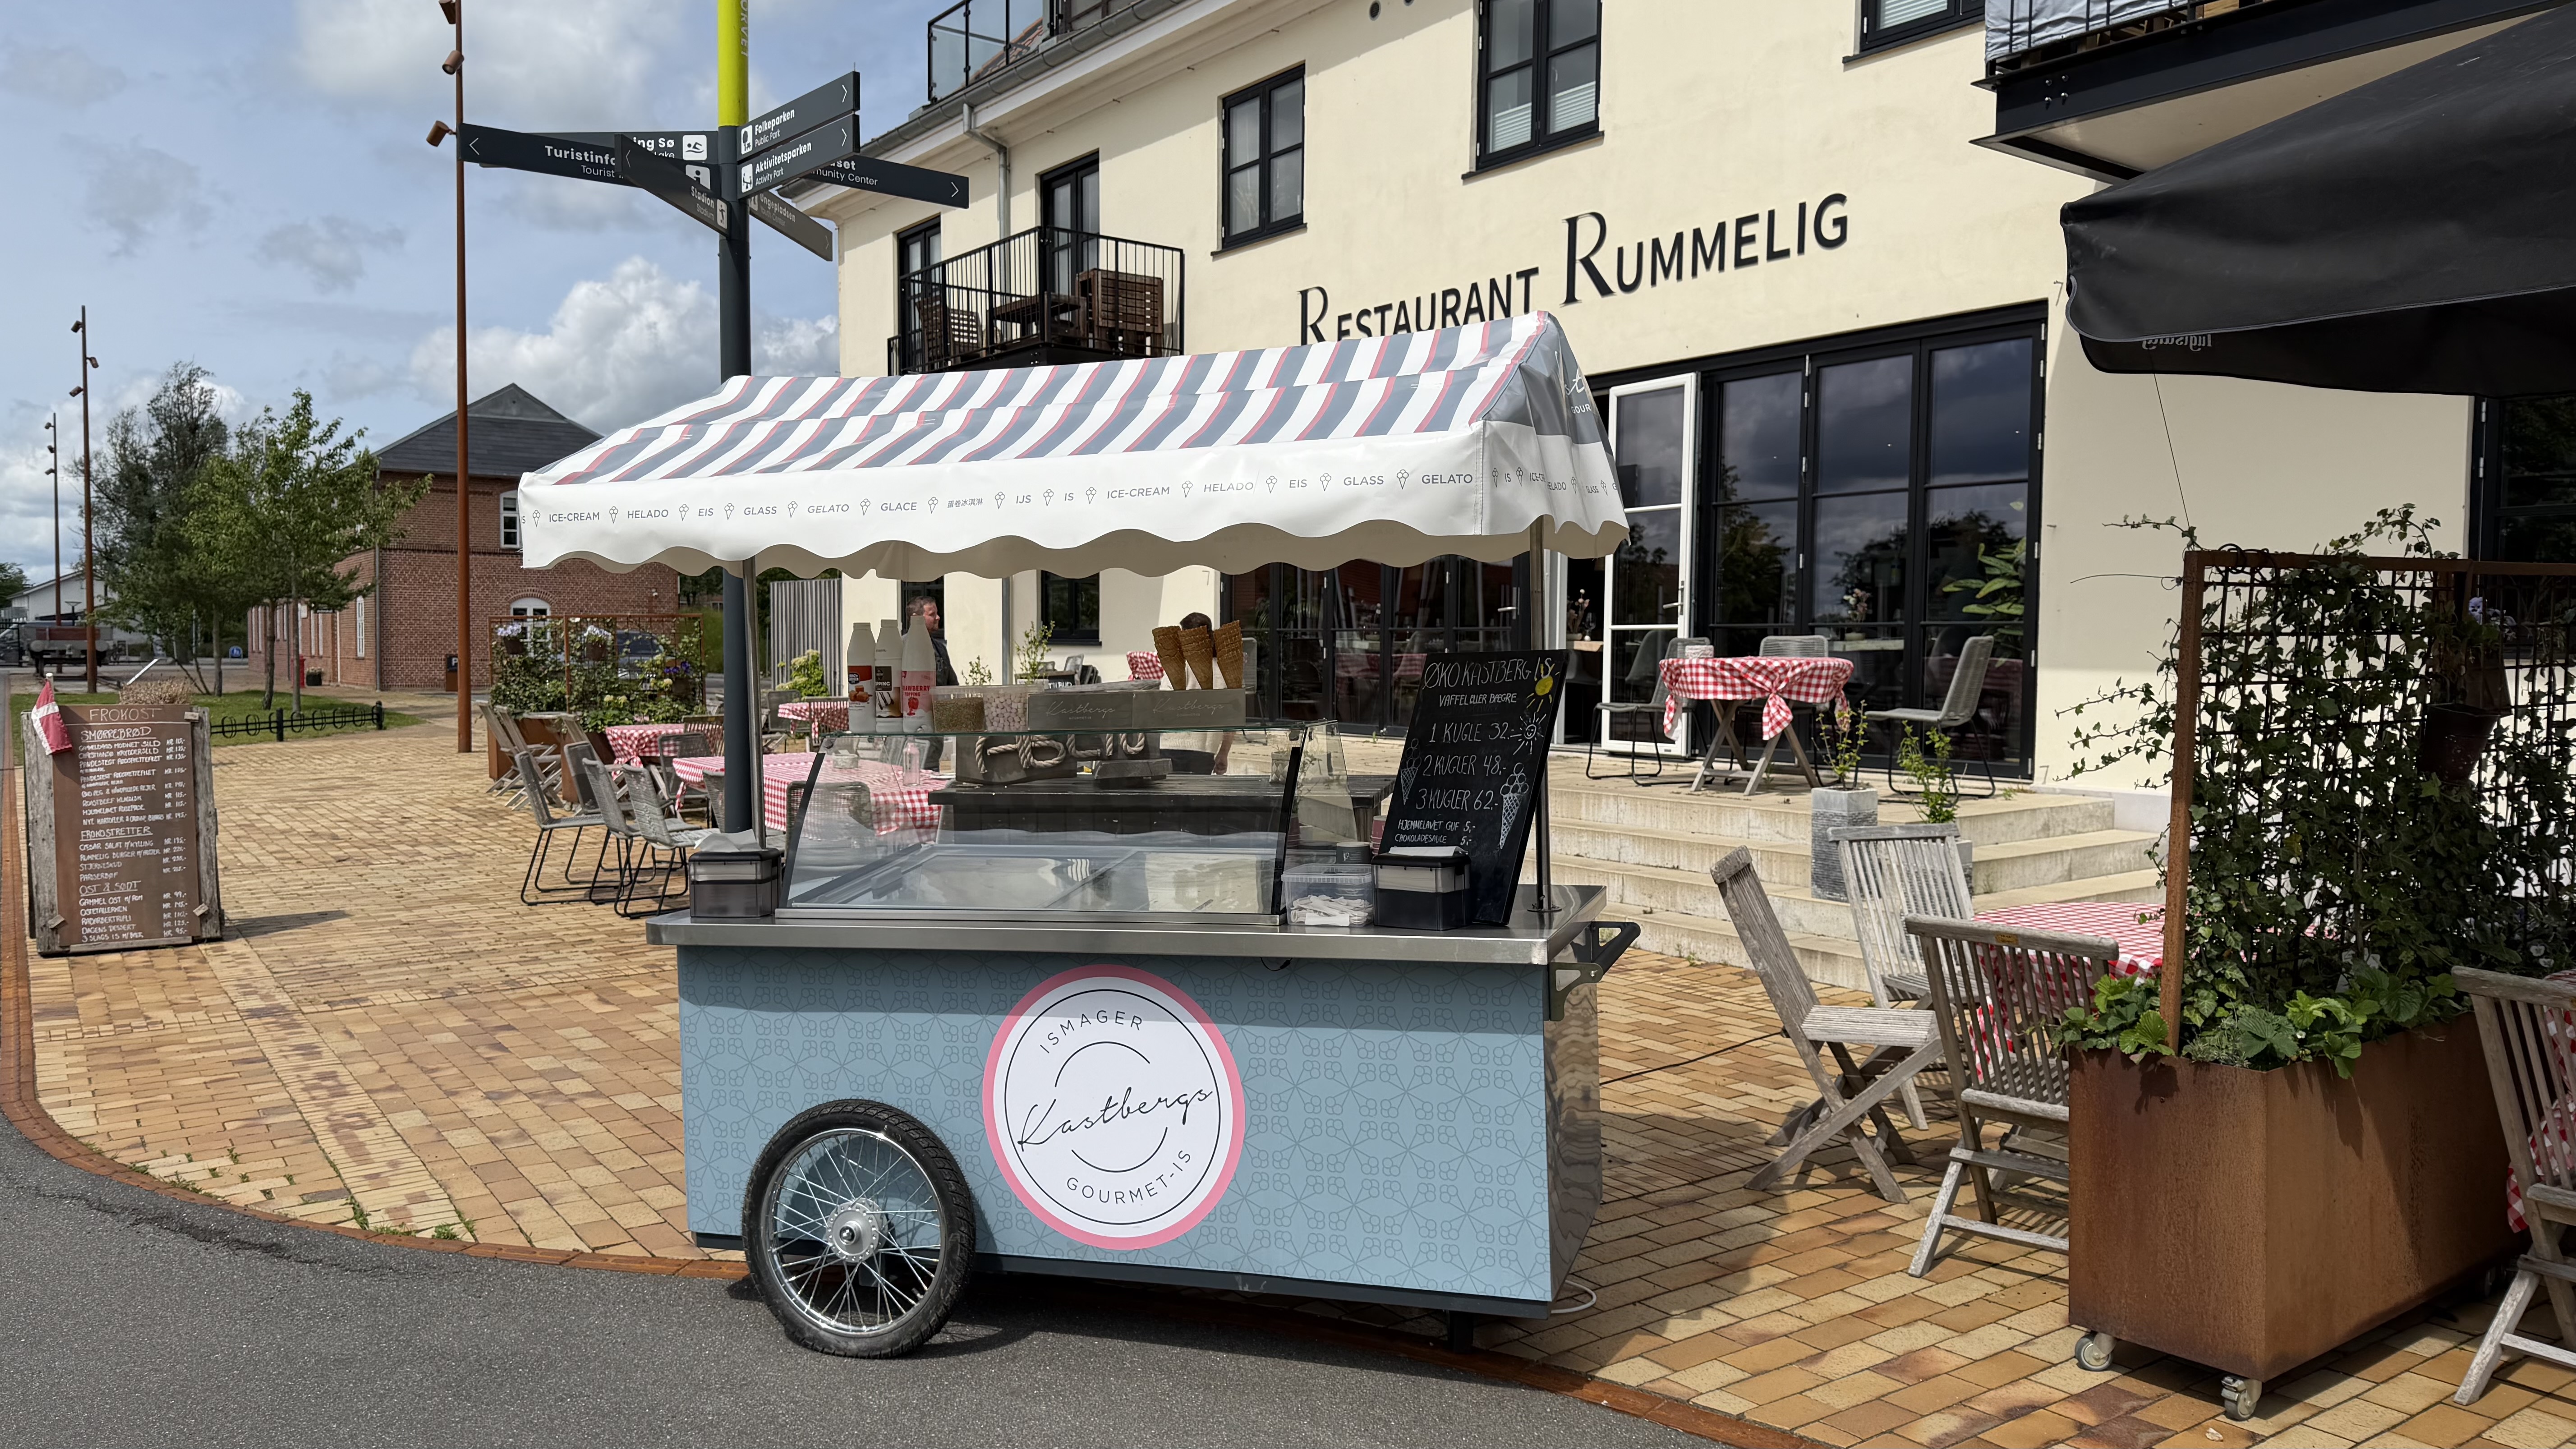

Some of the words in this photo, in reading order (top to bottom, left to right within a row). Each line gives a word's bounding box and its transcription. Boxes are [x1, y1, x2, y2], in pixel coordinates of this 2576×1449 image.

[754, 109, 795, 135] Folkeparken
[633, 137, 654, 151] ing
[658, 138, 674, 148] Sø
[754, 135, 769, 148] Public
[770, 129, 781, 142] Park
[755, 142, 812, 174] Aktivitetsparken
[581, 165, 615, 178] Tourist
[755, 173, 773, 186] Activity
[773, 167, 784, 179] Park
[848, 173, 878, 185] Center
[691, 186, 715, 209] Stadion
[697, 203, 715, 221] Stadium
[760, 193, 796, 222] Ungepladsen
[1297, 266, 1540, 346] RESTAURANT
[1559, 193, 1849, 308] RUMMELIG
[1504, 473, 1512, 483] IS
[1586, 485, 1599, 493] GLASS
[548, 511, 600, 523] ICE-CREAM
[626, 509, 669, 520] HELADO
[698, 508, 714, 517] EIS
[744, 506, 777, 516] GLASS
[807, 504, 850, 514] GELATO
[879, 501, 917, 513] GLACE
[1015, 494, 1032, 505] IJS
[1063, 492, 1074, 502] IS
[1106, 486, 1170, 500] ICE-CREAM
[1203, 482, 1254, 493] HELADO
[1288, 478, 1307, 488] EIS
[1343, 475, 1385, 486] GLASS
[1421, 473, 1473, 485] GELATO
[452, 658, 458, 666] P
[1422, 661, 1461, 690] ØKO
[1461, 658, 1532, 687] KASTBERG
[1533, 657, 1552, 682] IS
[1046, 700, 1116, 719] Kastbergs
[1153, 698, 1224, 715] Kastbergs
[1439, 694, 1470, 707] VAFFEL
[89, 708, 163, 722] FROKOST
[81, 726, 152, 741] SMØRREBRØD
[1428, 722, 1436, 743] 1
[1443, 722, 1482, 743] KUGLE
[1422, 754, 1434, 777] 2
[1433, 754, 1476, 777] KUGLER
[1416, 788, 1428, 810] 3
[1427, 788, 1468, 811] KUGLER
[81, 826, 152, 840] FROKOSTRETTER
[1397, 820, 1444, 830] HJEMMELAVET
[1445, 820, 1460, 831] GUF
[79, 853, 110, 862] RUMMELIG
[112, 851, 136, 859] BURGER
[79, 871, 118, 882] PARISERBØF
[79, 884, 101, 895] OST
[79, 897, 108, 906] GAMMEL
[108, 896, 122, 904] OST
[82, 926, 107, 935] DAGENS
[108, 924, 137, 932] DESSERT
[89, 934, 110, 942] SLAGS
[1039, 1009, 1144, 1053] ISMAGER
[1017, 1086, 1213, 1152] Kastbergs
[1067, 1150, 1191, 1205] GOURMET-IS
